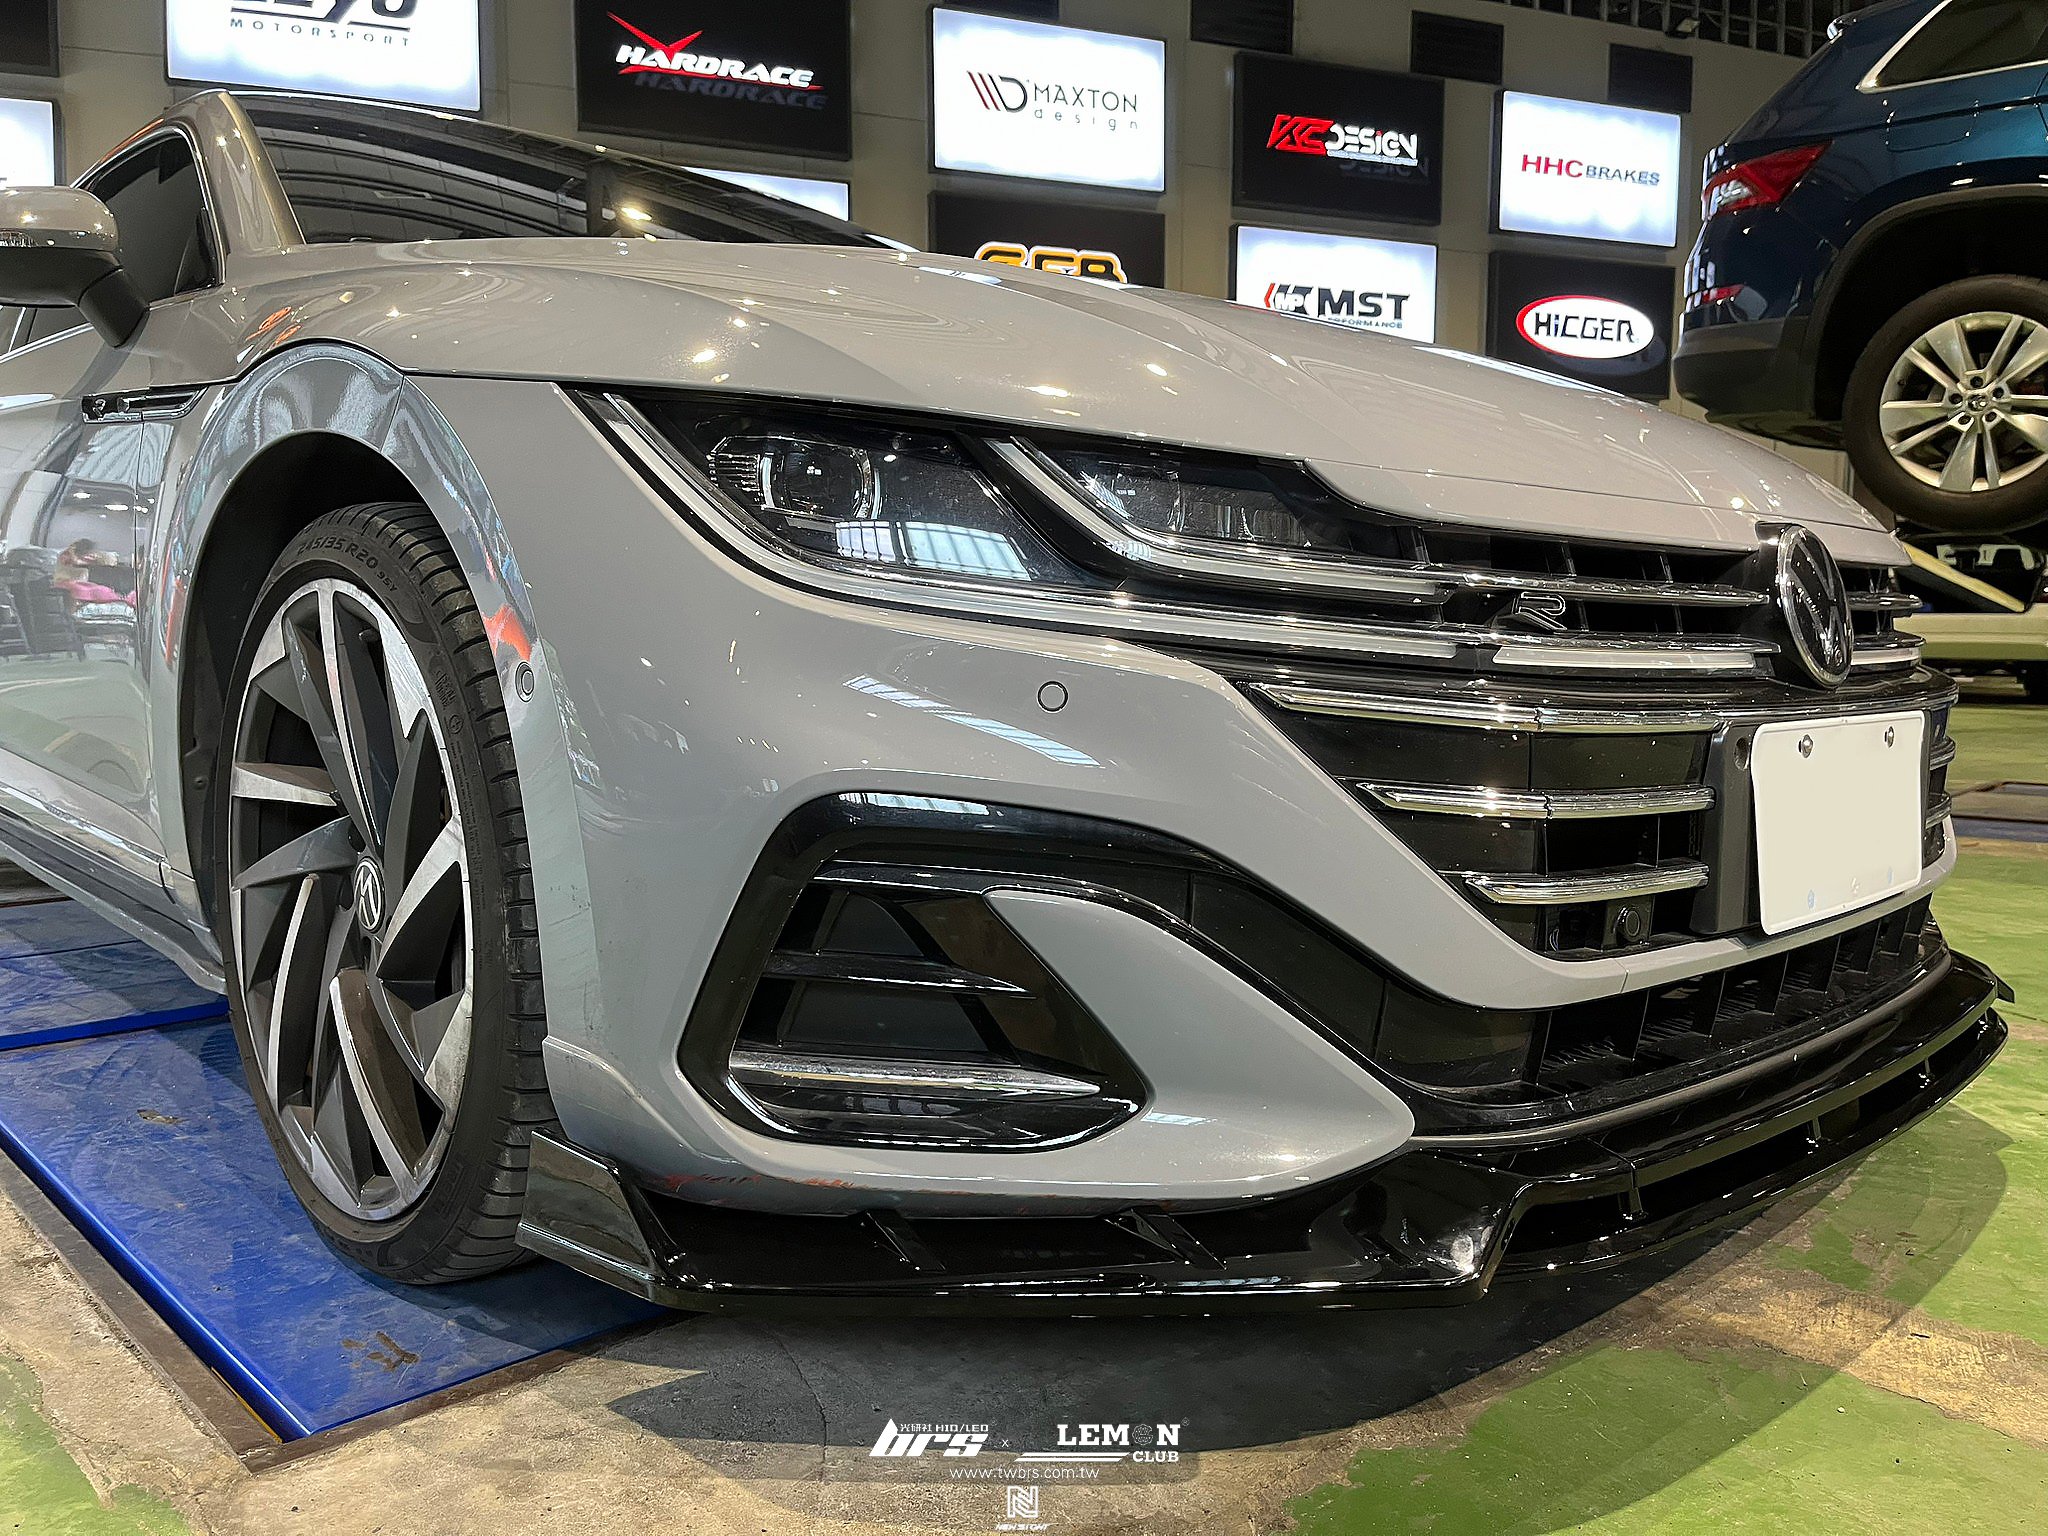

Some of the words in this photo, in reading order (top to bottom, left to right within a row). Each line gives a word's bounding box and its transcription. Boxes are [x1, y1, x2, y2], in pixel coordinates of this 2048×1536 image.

[230, 18, 409, 46] MOTORSPORT
[615, 44, 815, 88] HARDRACE
[1034, 83, 1137, 113] MAXTON
[1034, 108, 1138, 131] design
[1521, 154, 1584, 178] HHC
[1586, 165, 1661, 186] BRAKES
[1317, 287, 1410, 321] MST
